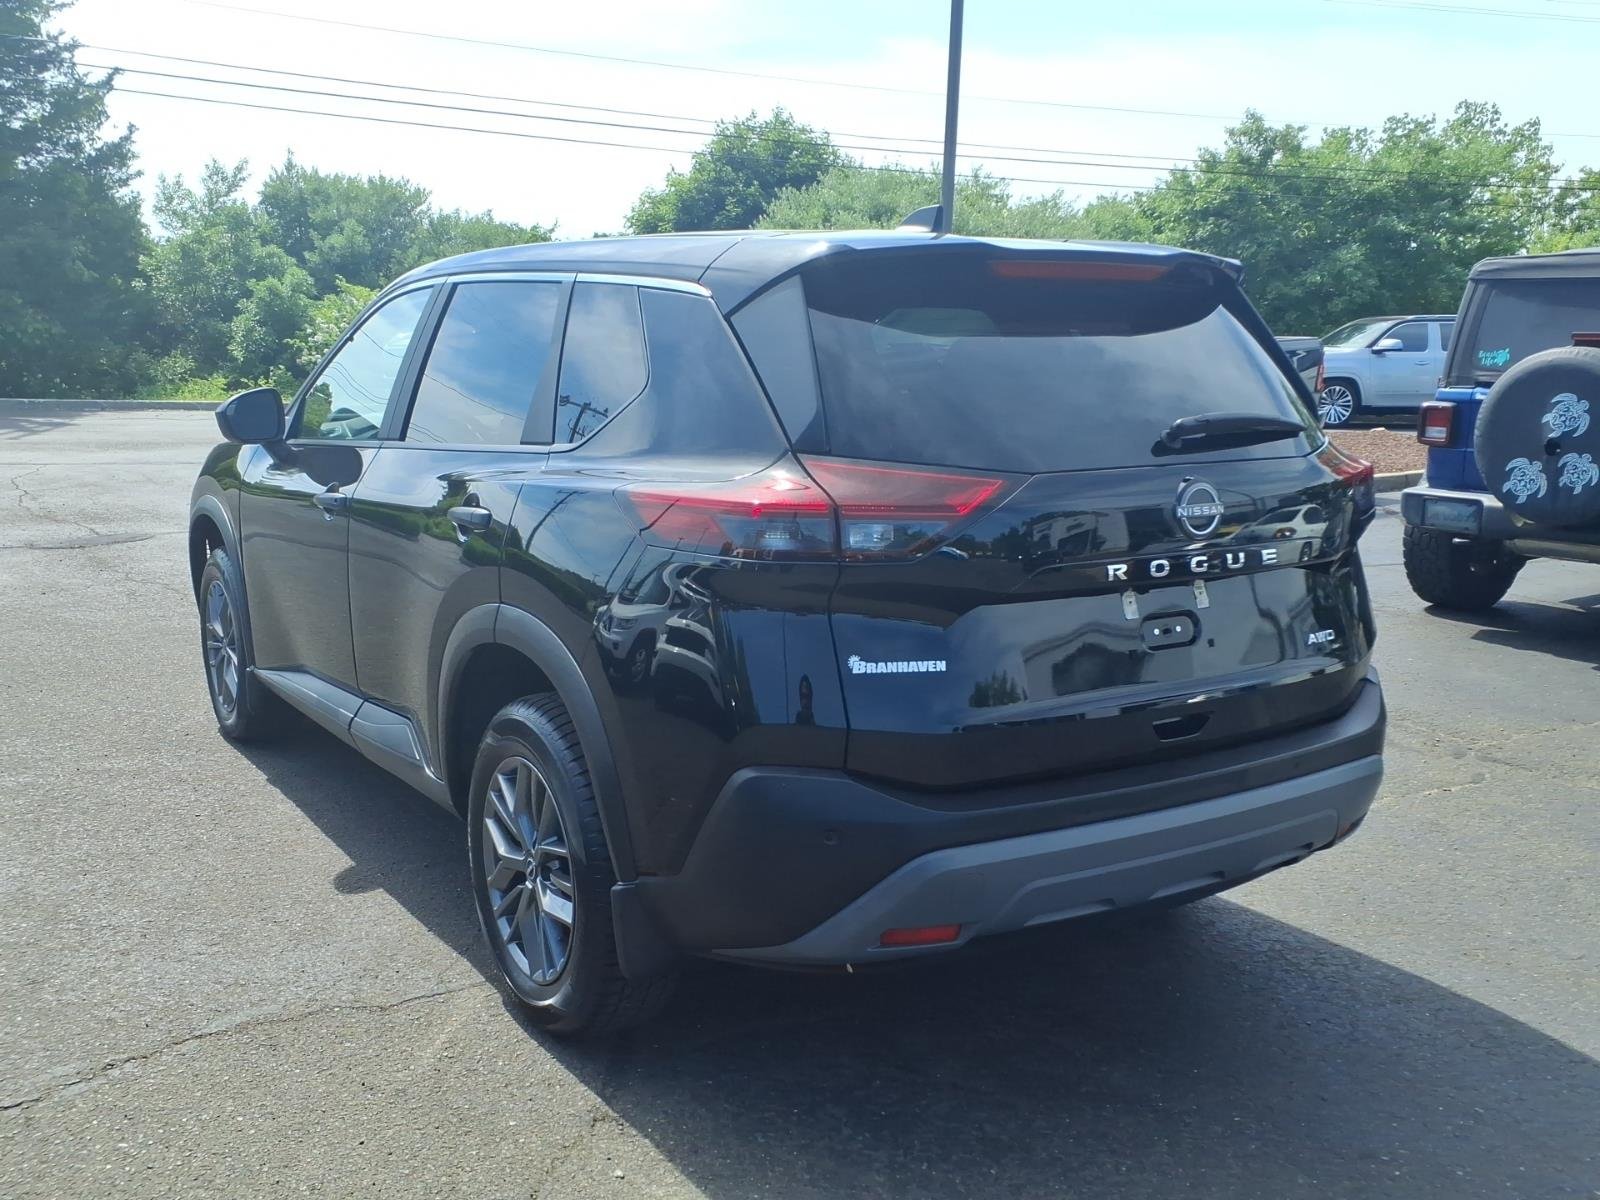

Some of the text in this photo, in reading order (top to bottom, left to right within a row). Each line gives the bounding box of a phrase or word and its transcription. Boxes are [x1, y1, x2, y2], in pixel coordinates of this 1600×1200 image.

[1178, 505, 1224, 517] NISSAN
[1107, 549, 1278, 581] ROGUE
[1308, 630, 1335, 644] AWD
[852, 660, 947, 674] BRANHAVEN
